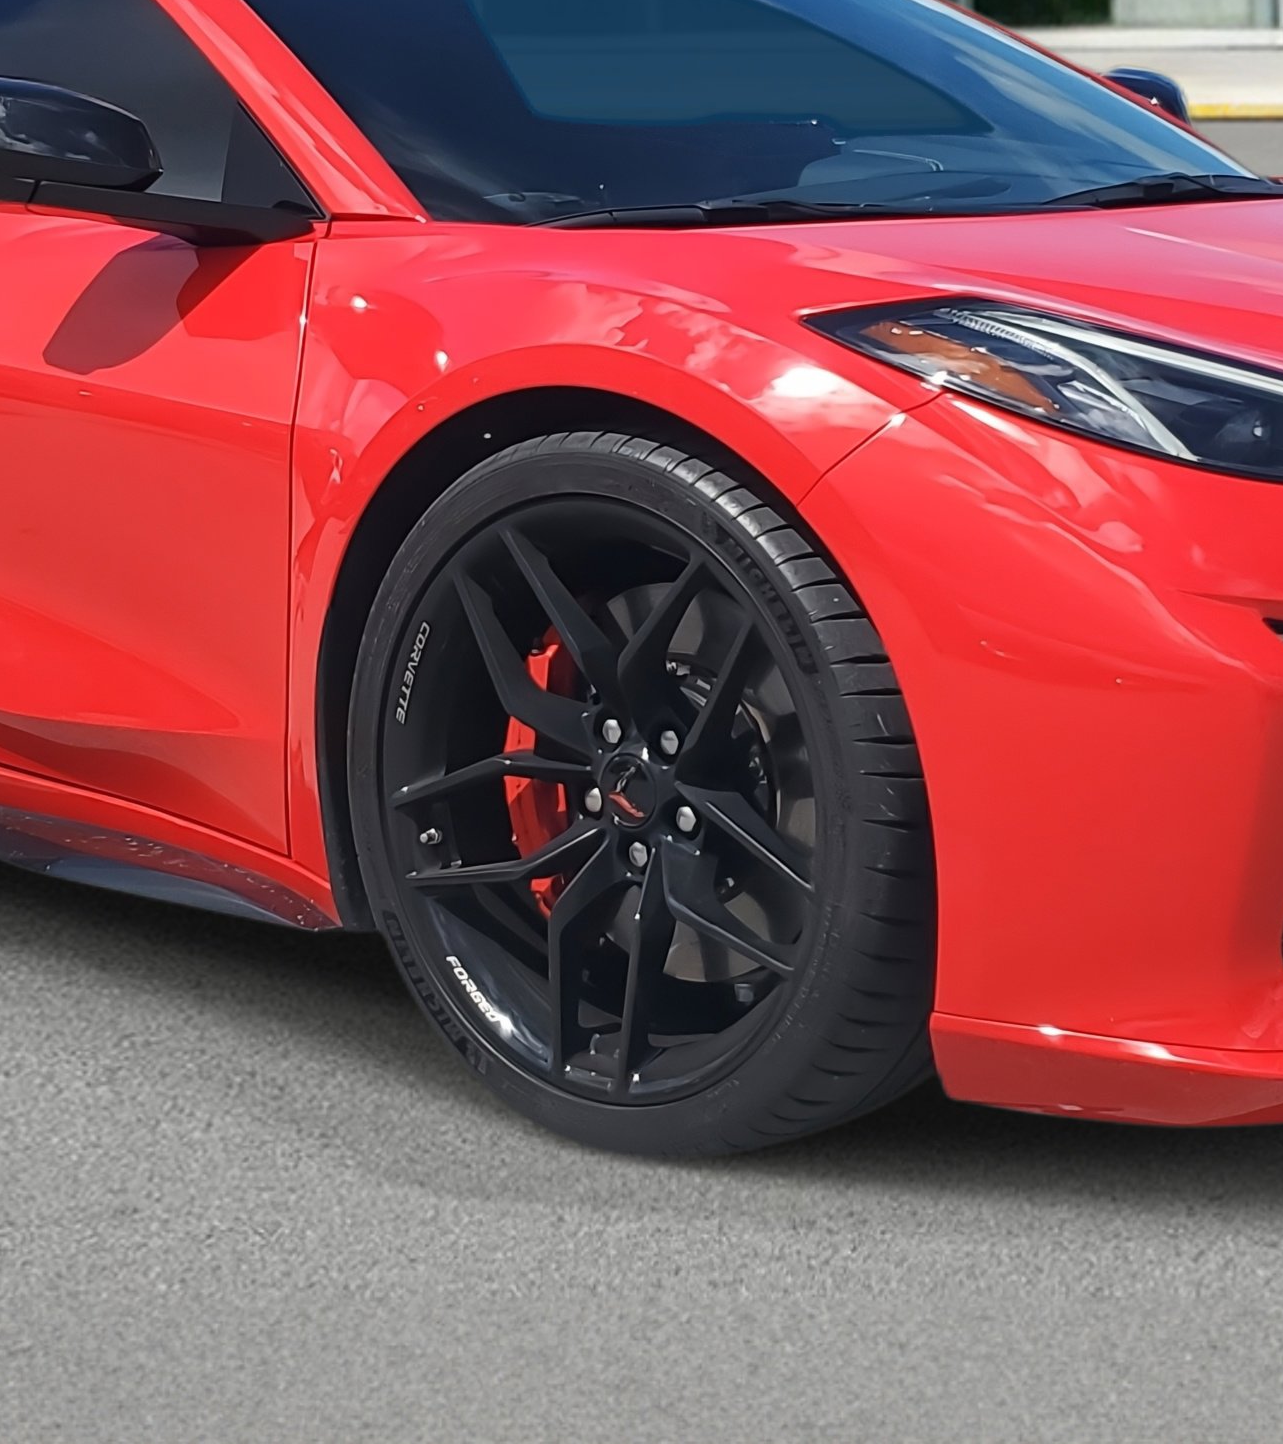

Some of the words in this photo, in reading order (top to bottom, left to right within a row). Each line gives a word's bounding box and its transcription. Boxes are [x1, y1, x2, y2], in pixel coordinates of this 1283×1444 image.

[719, 535, 814, 668] MICHELIN
[395, 621, 431, 725] CORVETTE
[383, 917, 464, 1043] MICHELIN
[445, 955, 501, 1023] FORGED
